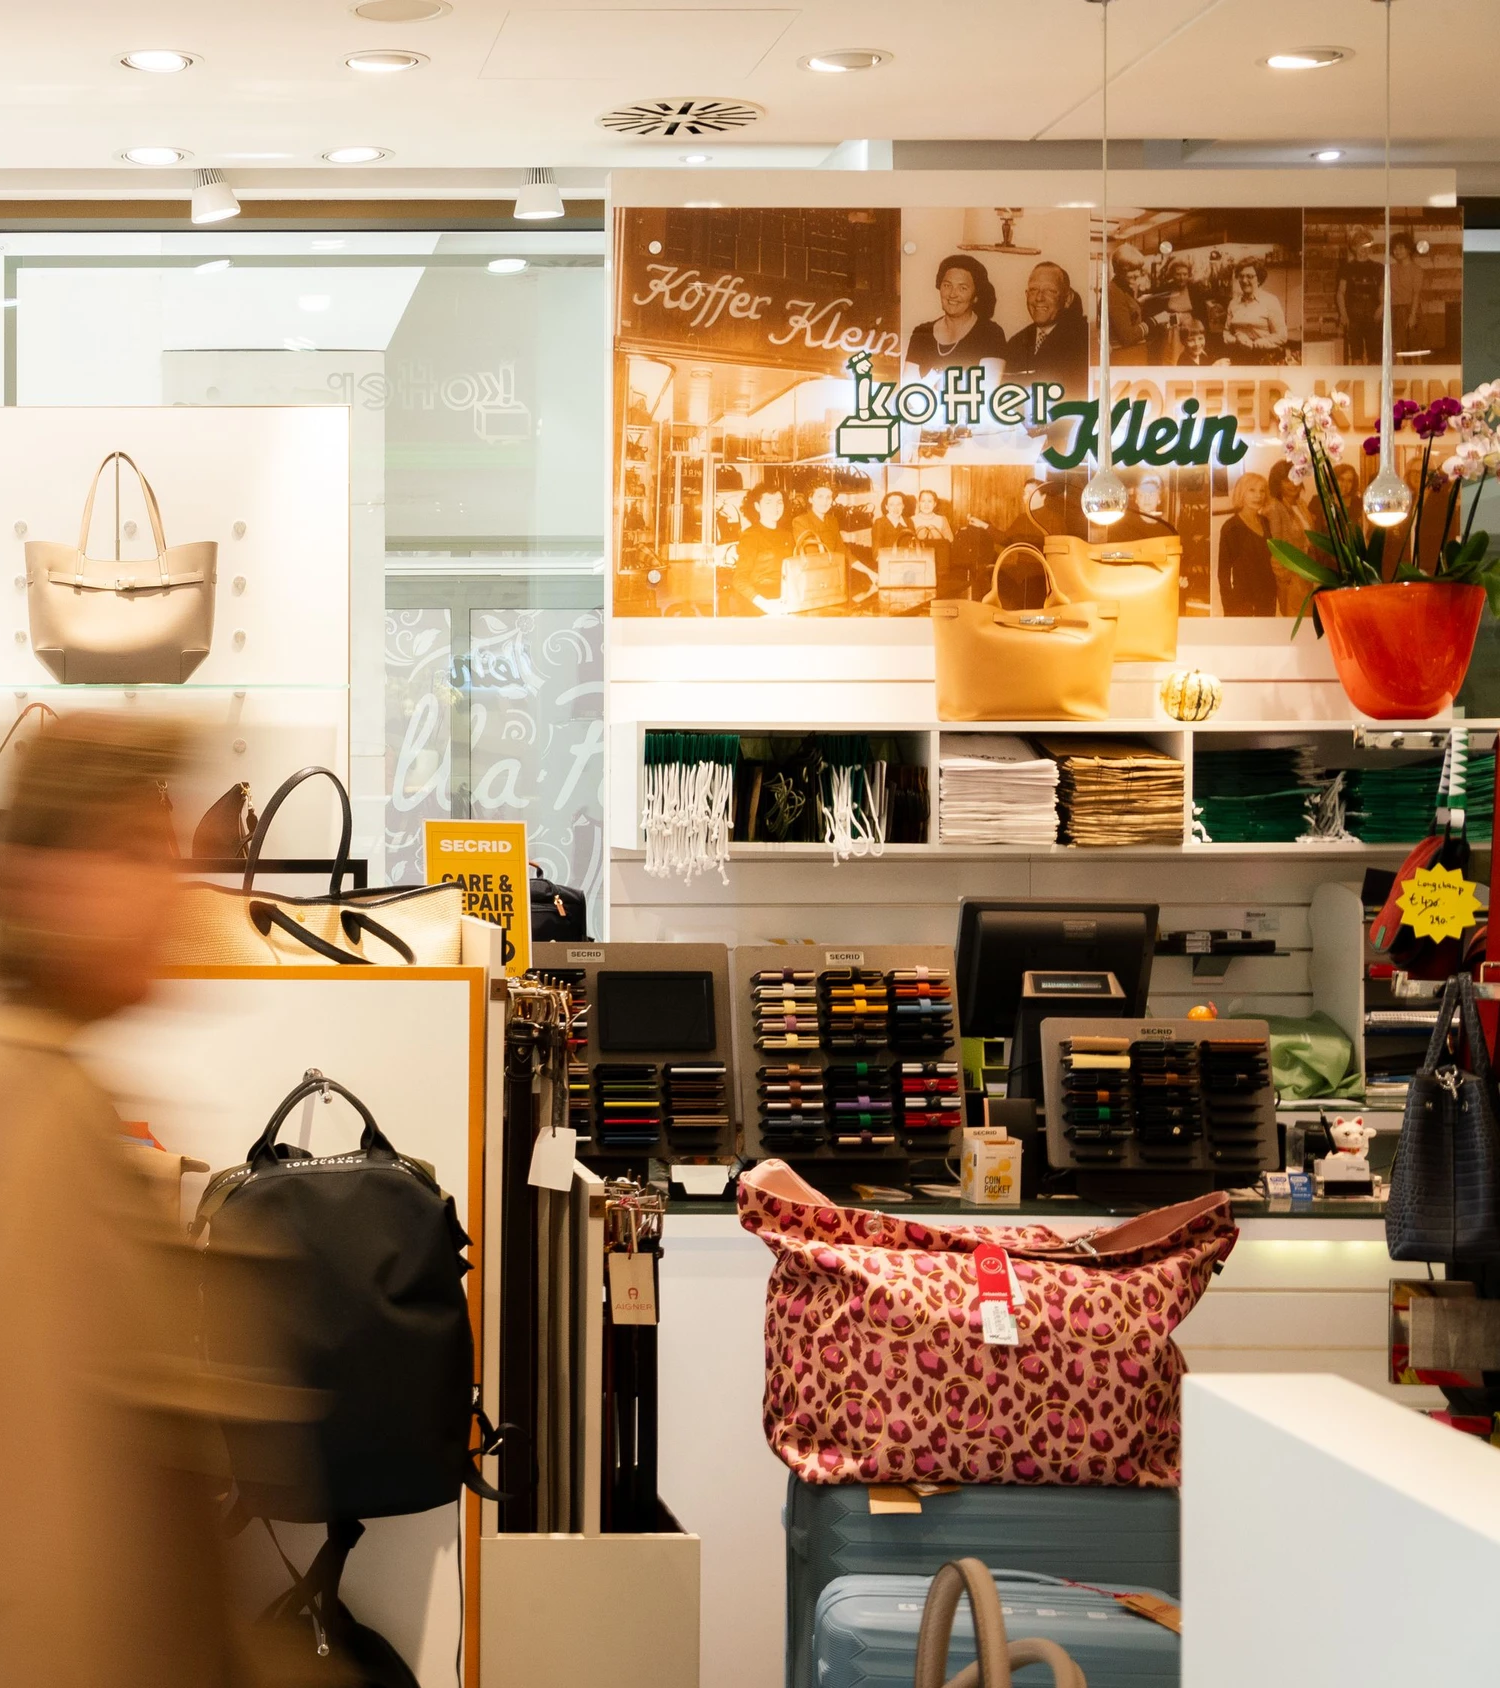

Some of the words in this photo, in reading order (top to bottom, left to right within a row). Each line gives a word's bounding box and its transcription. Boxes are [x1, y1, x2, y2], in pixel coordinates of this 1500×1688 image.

[633, 263, 771, 328] Koffer
[768, 298, 902, 357] Klein
[852, 363, 1066, 428] koffer
[1042, 396, 1250, 470] Klein
[439, 839, 512, 853] SECRID
[499, 874, 513, 892] &
[1417, 880, 1464, 896] Longchamp
[462, 893, 514, 912] PAIR
[462, 912, 515, 931] INT
[1140, 1027, 1173, 1036] SECRID
[286, 1158, 363, 1169] LONGCHAMP
[984, 1175, 1001, 1185] COIN
[984, 1184, 1012, 1194] POCKET
